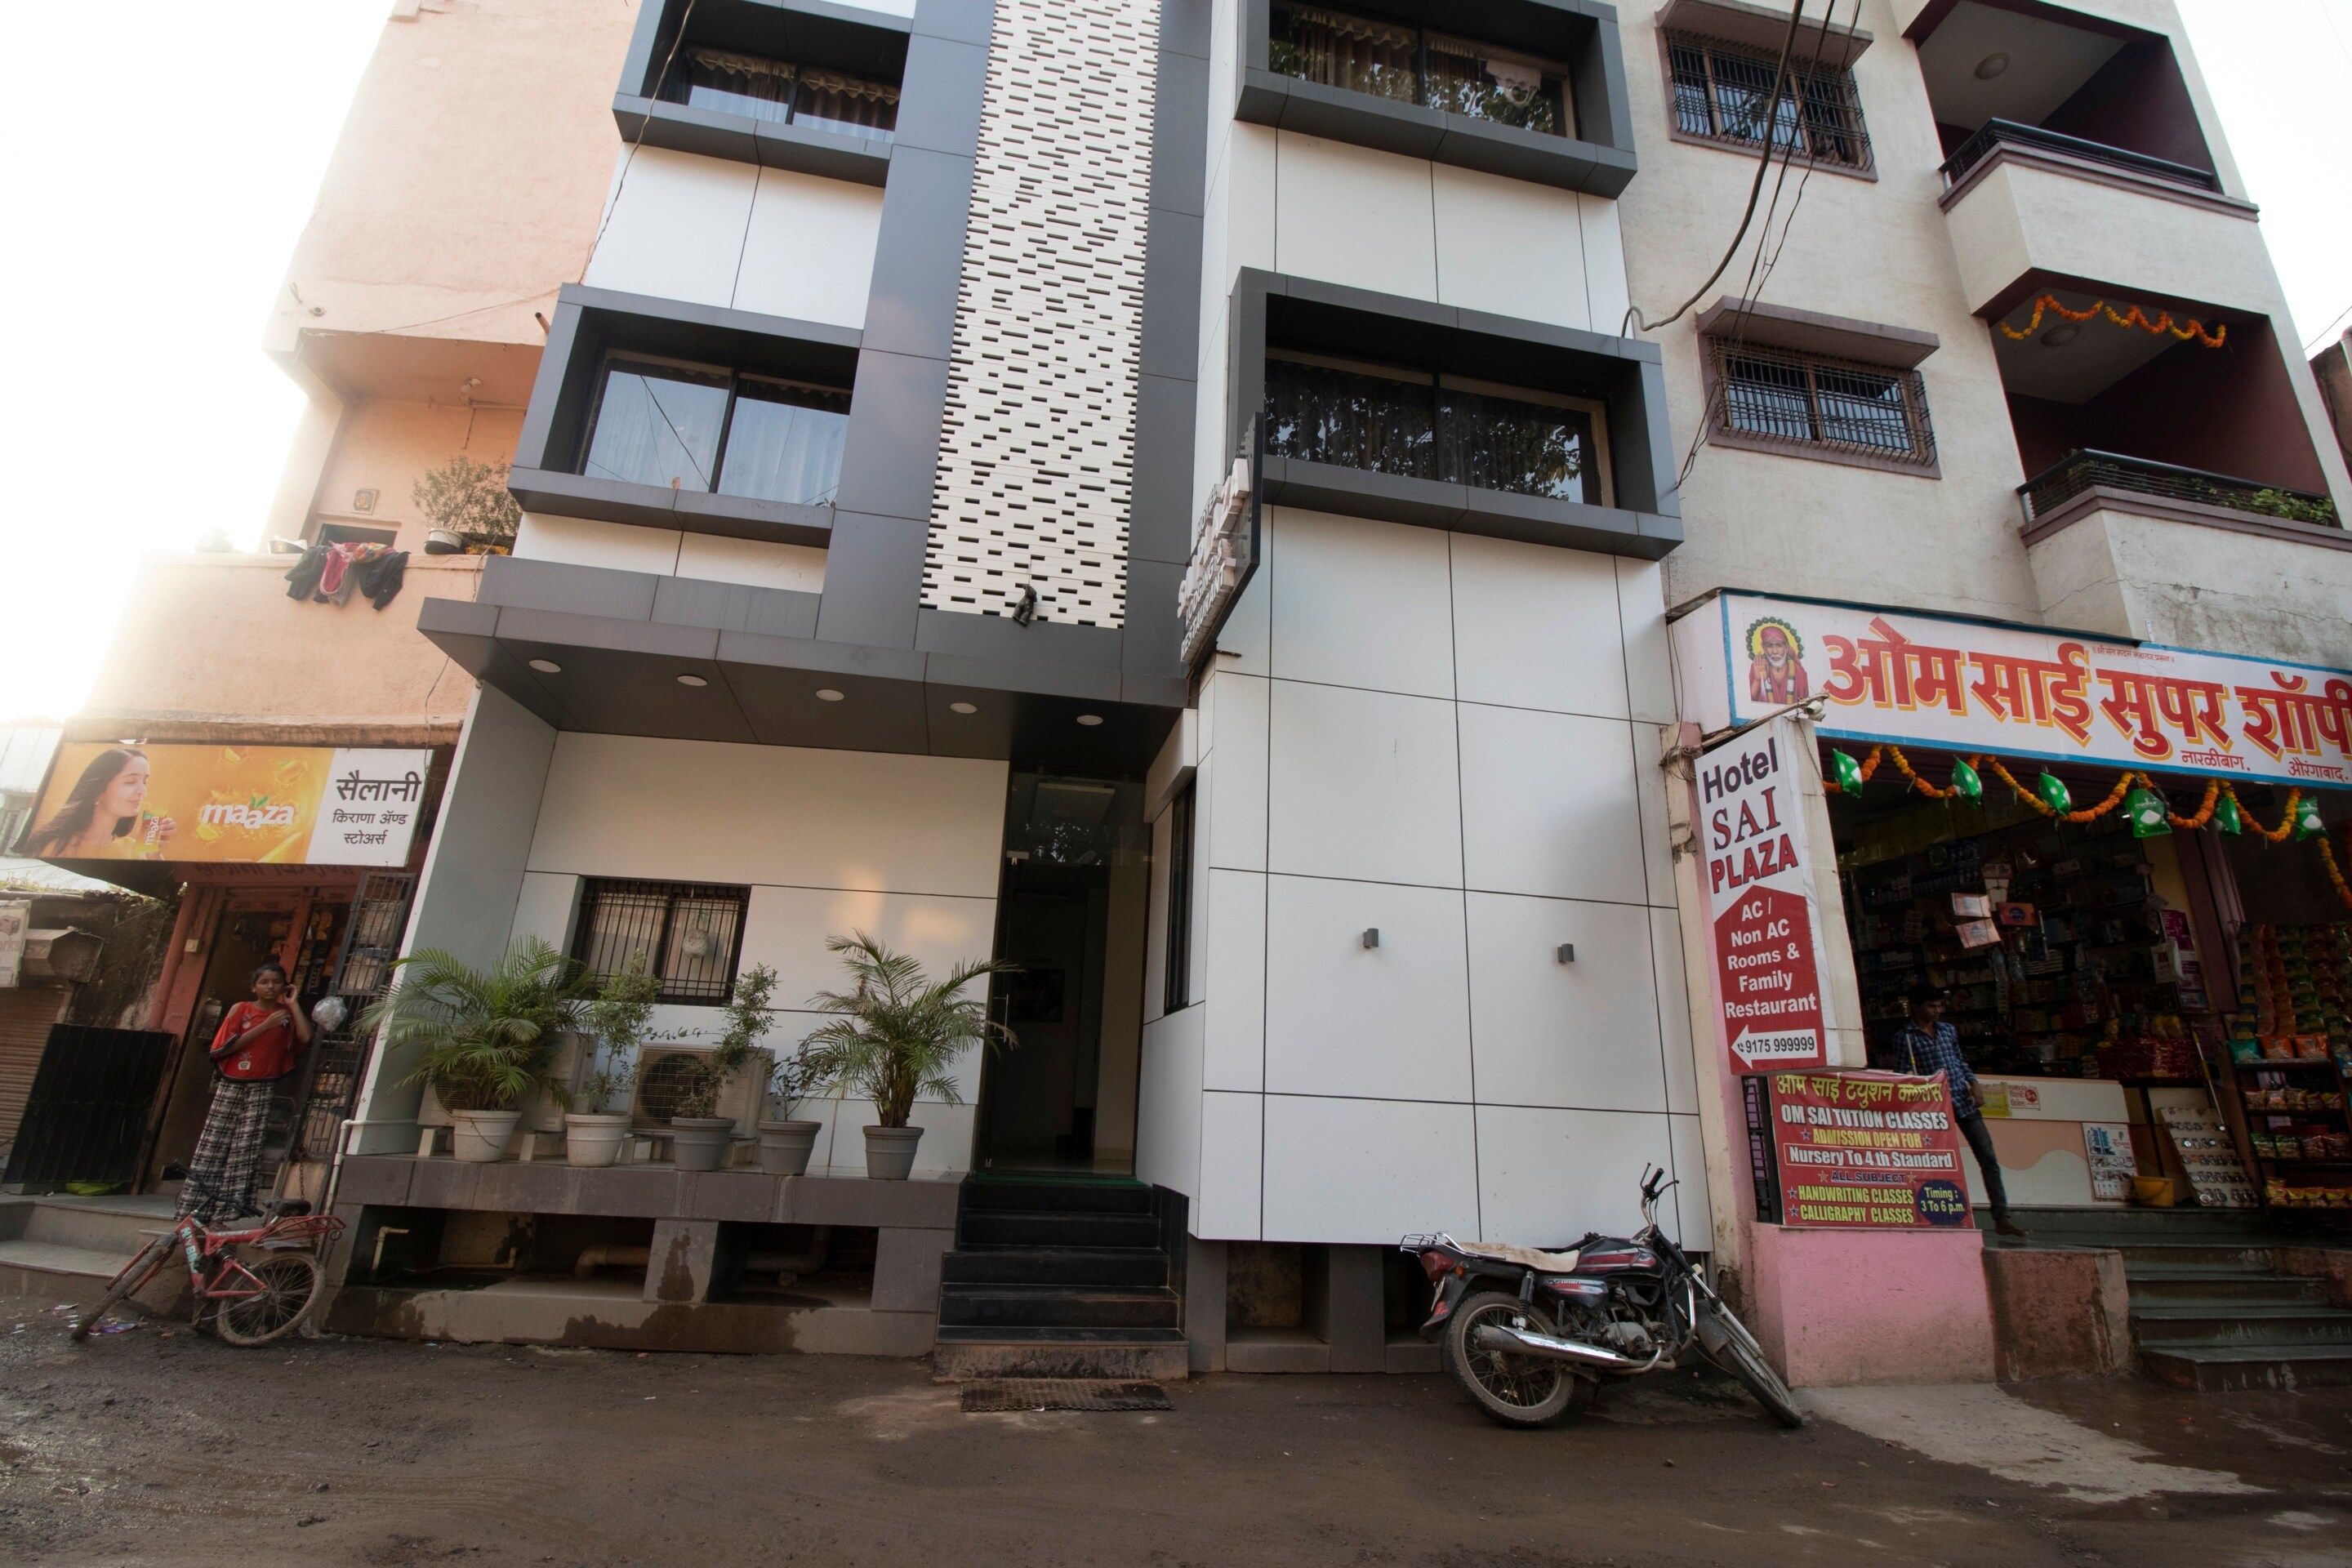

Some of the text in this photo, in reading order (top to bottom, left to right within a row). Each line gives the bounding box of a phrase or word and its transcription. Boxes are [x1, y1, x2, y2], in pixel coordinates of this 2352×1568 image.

[1822, 617, 1967, 716] ओम
[1968, 642, 2093, 748] साई
[2096, 668, 2234, 760] सुपर
[1703, 737, 1778, 804] Hotel
[336, 770, 421, 801] सैलानी
[203, 804, 295, 829] maaza
[332, 808, 376, 823] किराणा
[1713, 786, 1781, 851] SAI
[145, 817, 159, 845] maaza
[344, 830, 388, 844] स्टोअर्स
[1710, 833, 1798, 894] PLAZA
[1741, 901, 1763, 922] AC
[1731, 918, 1790, 947] Non AC
[1727, 942, 1800, 970] Rooms &
[1739, 969, 1793, 992] Family
[1725, 992, 1817, 1018] Restaurant
[1745, 1036, 1815, 1054] 9175 999999
[1781, 1104, 1949, 1130] OM SAI TUTION CLASSES
[1813, 1128, 1922, 1148] ADMISSION OPEN FOR
[1789, 1146, 1953, 1168] Nursery To 4 th Standard
[1831, 1171, 1906, 1183] ALL SUBJECT
[1797, 1185, 1914, 1205] HANDWRITING CLASSES
[1924, 1187, 1953, 1201] Timing
[1800, 1205, 1914, 1223] CALLIGRAPHY CLASSES
[1921, 1200, 1927, 1212] 3
[1927, 1200, 1940, 1212] To
[1940, 1200, 1947, 1212] 6
